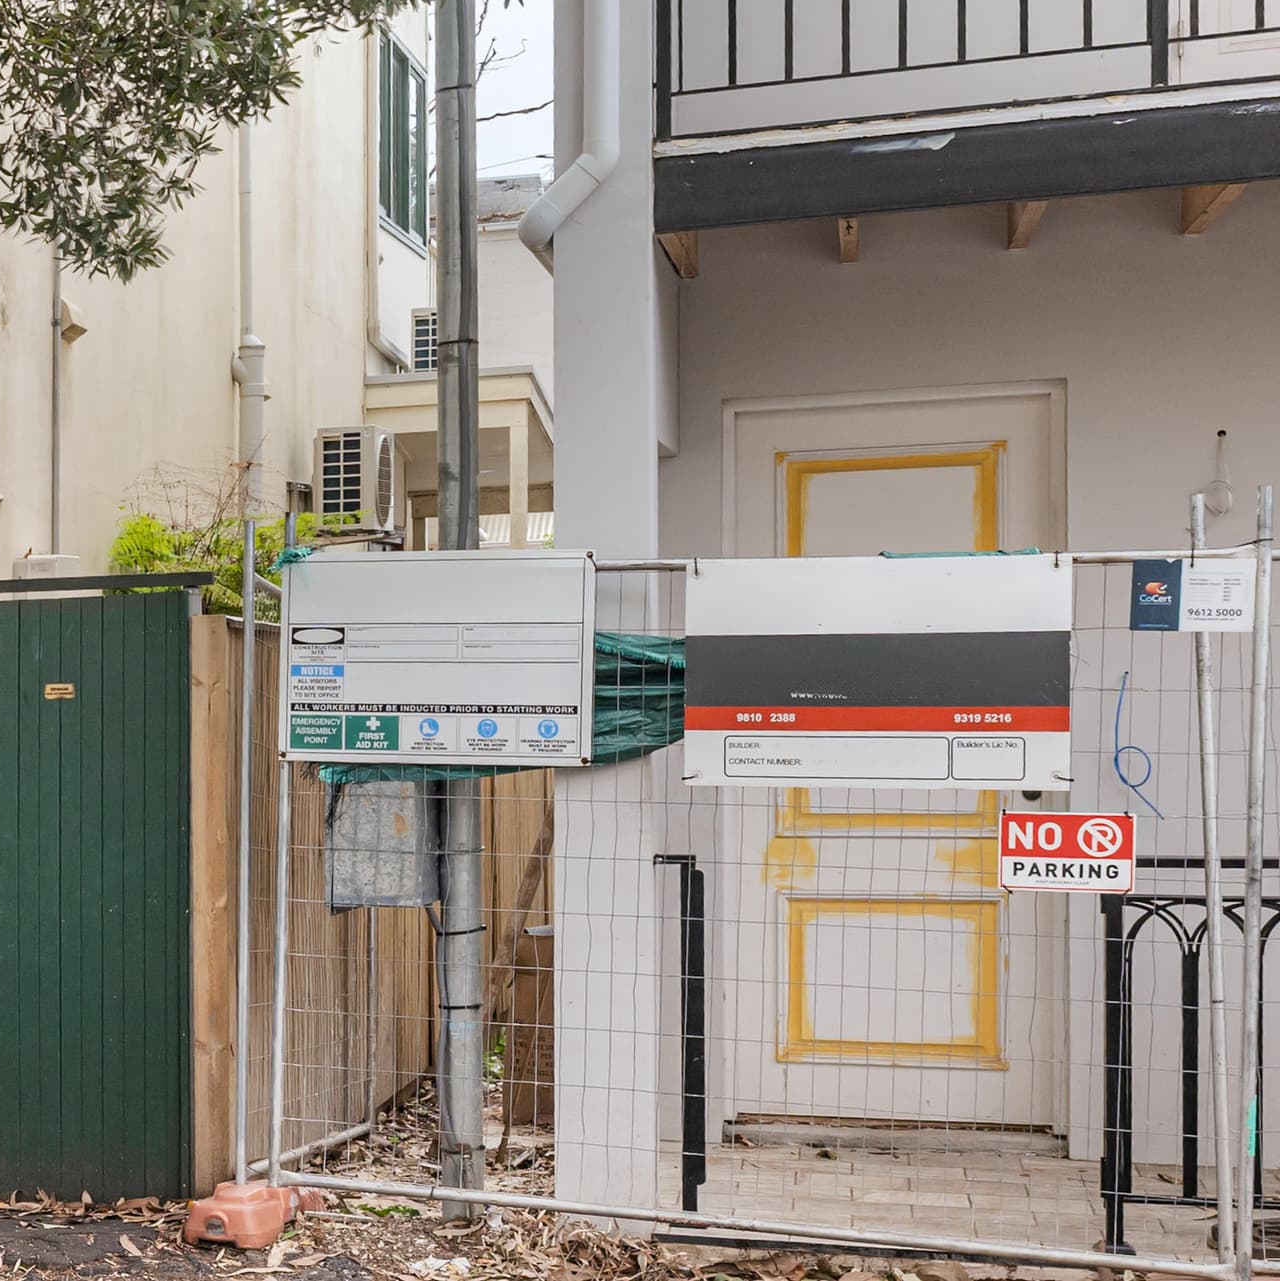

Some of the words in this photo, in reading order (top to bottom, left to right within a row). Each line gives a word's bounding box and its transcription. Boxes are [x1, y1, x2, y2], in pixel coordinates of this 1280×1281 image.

[1139, 594, 1172, 603] CoCert
[1187, 608, 1213, 617] 9612
[1215, 608, 1243, 617] 5000
[301, 666, 335, 676] NOTICE
[311, 704, 356, 712] WORKERS
[358, 704, 383, 712] MUST
[385, 704, 398, 712] BE
[400, 704, 448, 713] INDUCTED
[449, 705, 479, 713] PRIOR
[481, 705, 494, 713] TO
[496, 705, 543, 713] STARTING
[545, 706, 575, 714] WORK
[291, 717, 341, 725] EMERGENCY
[736, 712, 762, 722] 9810
[769, 712, 796, 722] 2388
[953, 712, 982, 723] 9319
[984, 712, 1013, 723] 5216
[295, 726, 338, 734] ASSEMBLY
[303, 736, 329, 744] POINT
[359, 732, 385, 740] FIRST
[355, 741, 371, 749] AID
[373, 741, 389, 749] KIT
[728, 757, 765, 765] CONTACT
[1008, 821, 1063, 851] NO
[1013, 861, 1120, 879] PARKING
